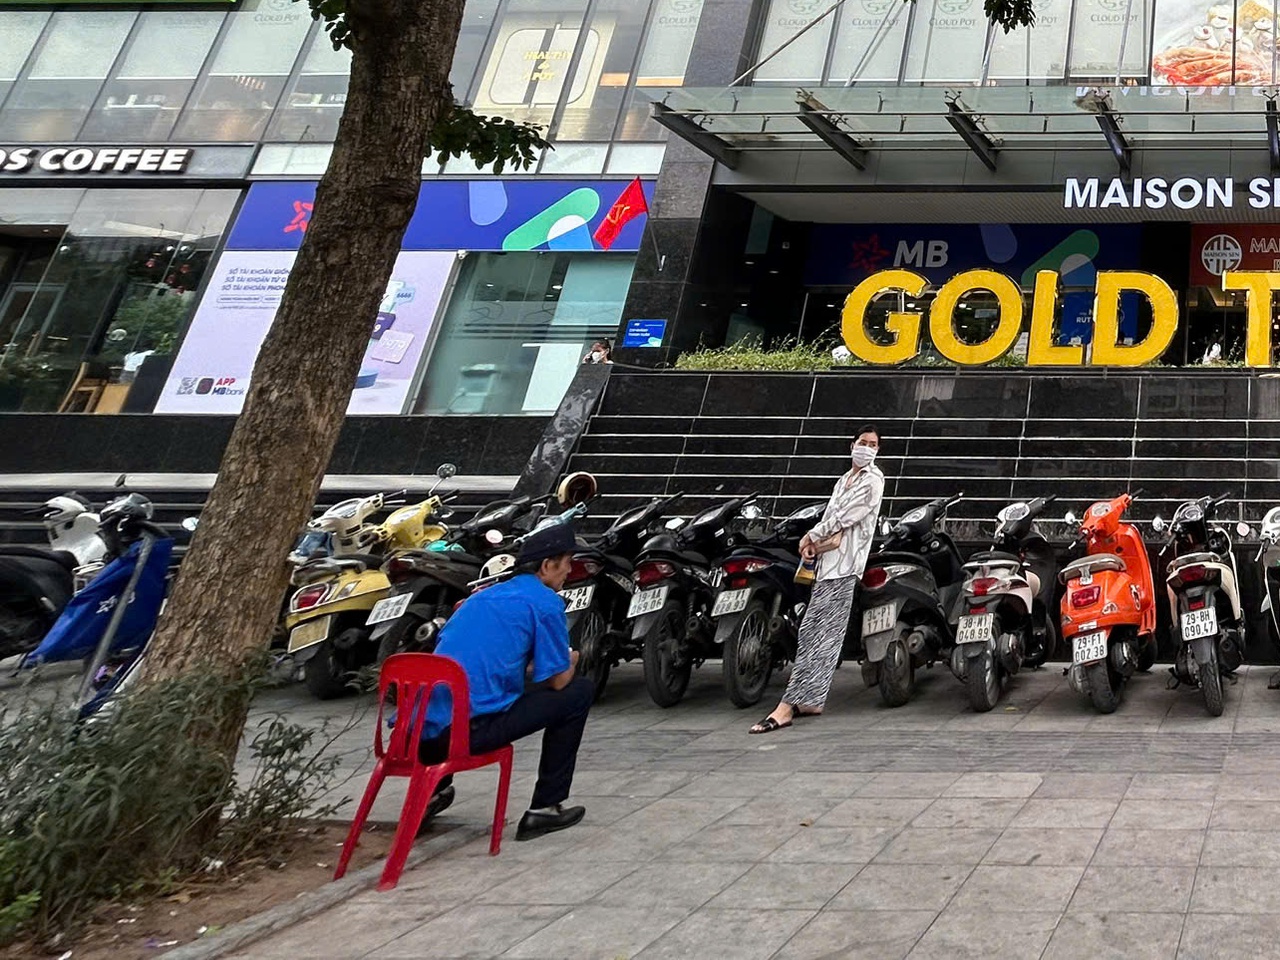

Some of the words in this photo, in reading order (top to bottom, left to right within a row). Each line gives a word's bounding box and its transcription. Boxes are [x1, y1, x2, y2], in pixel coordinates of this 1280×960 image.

[0, 148, 32, 171] S
[39, 148, 189, 172] COFFEE
[1063, 177, 1234, 210] MAISON
[893, 240, 949, 268] MB
[840, 268, 1181, 368] GOLD
[216, 377, 236, 386] APP
